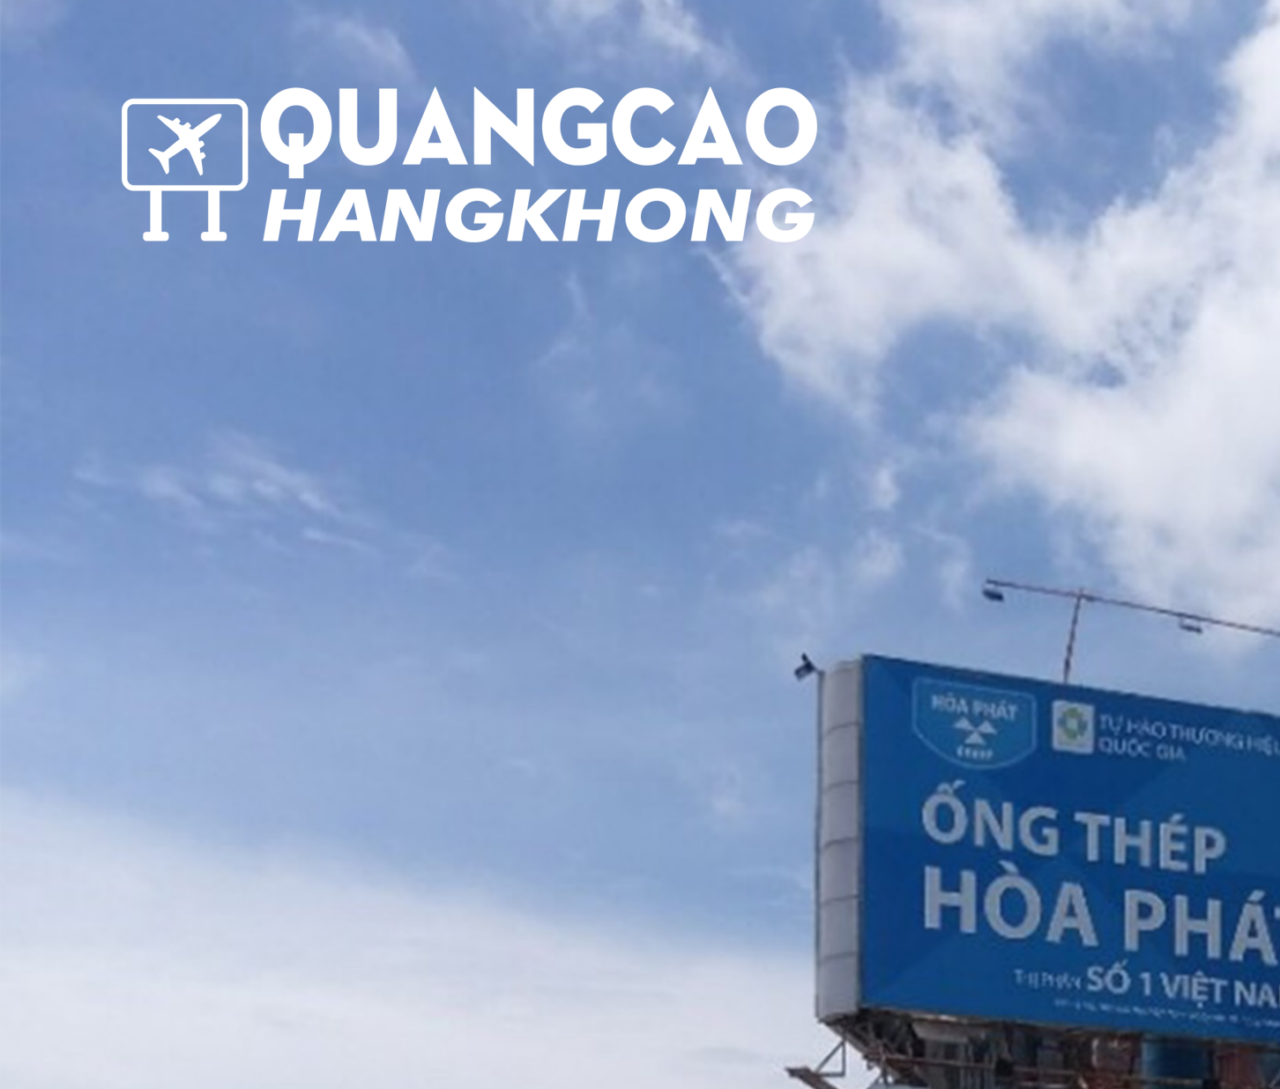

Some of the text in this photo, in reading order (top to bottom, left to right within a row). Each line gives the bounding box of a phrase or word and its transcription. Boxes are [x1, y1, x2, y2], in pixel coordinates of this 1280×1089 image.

[922, 780, 1227, 874] ỐNG THÉP
[924, 861, 1098, 948] HÒA
[1086, 959, 1131, 994] SỐ
[1139, 971, 1152, 996] 1
[1160, 970, 1228, 1009] VIỆT
